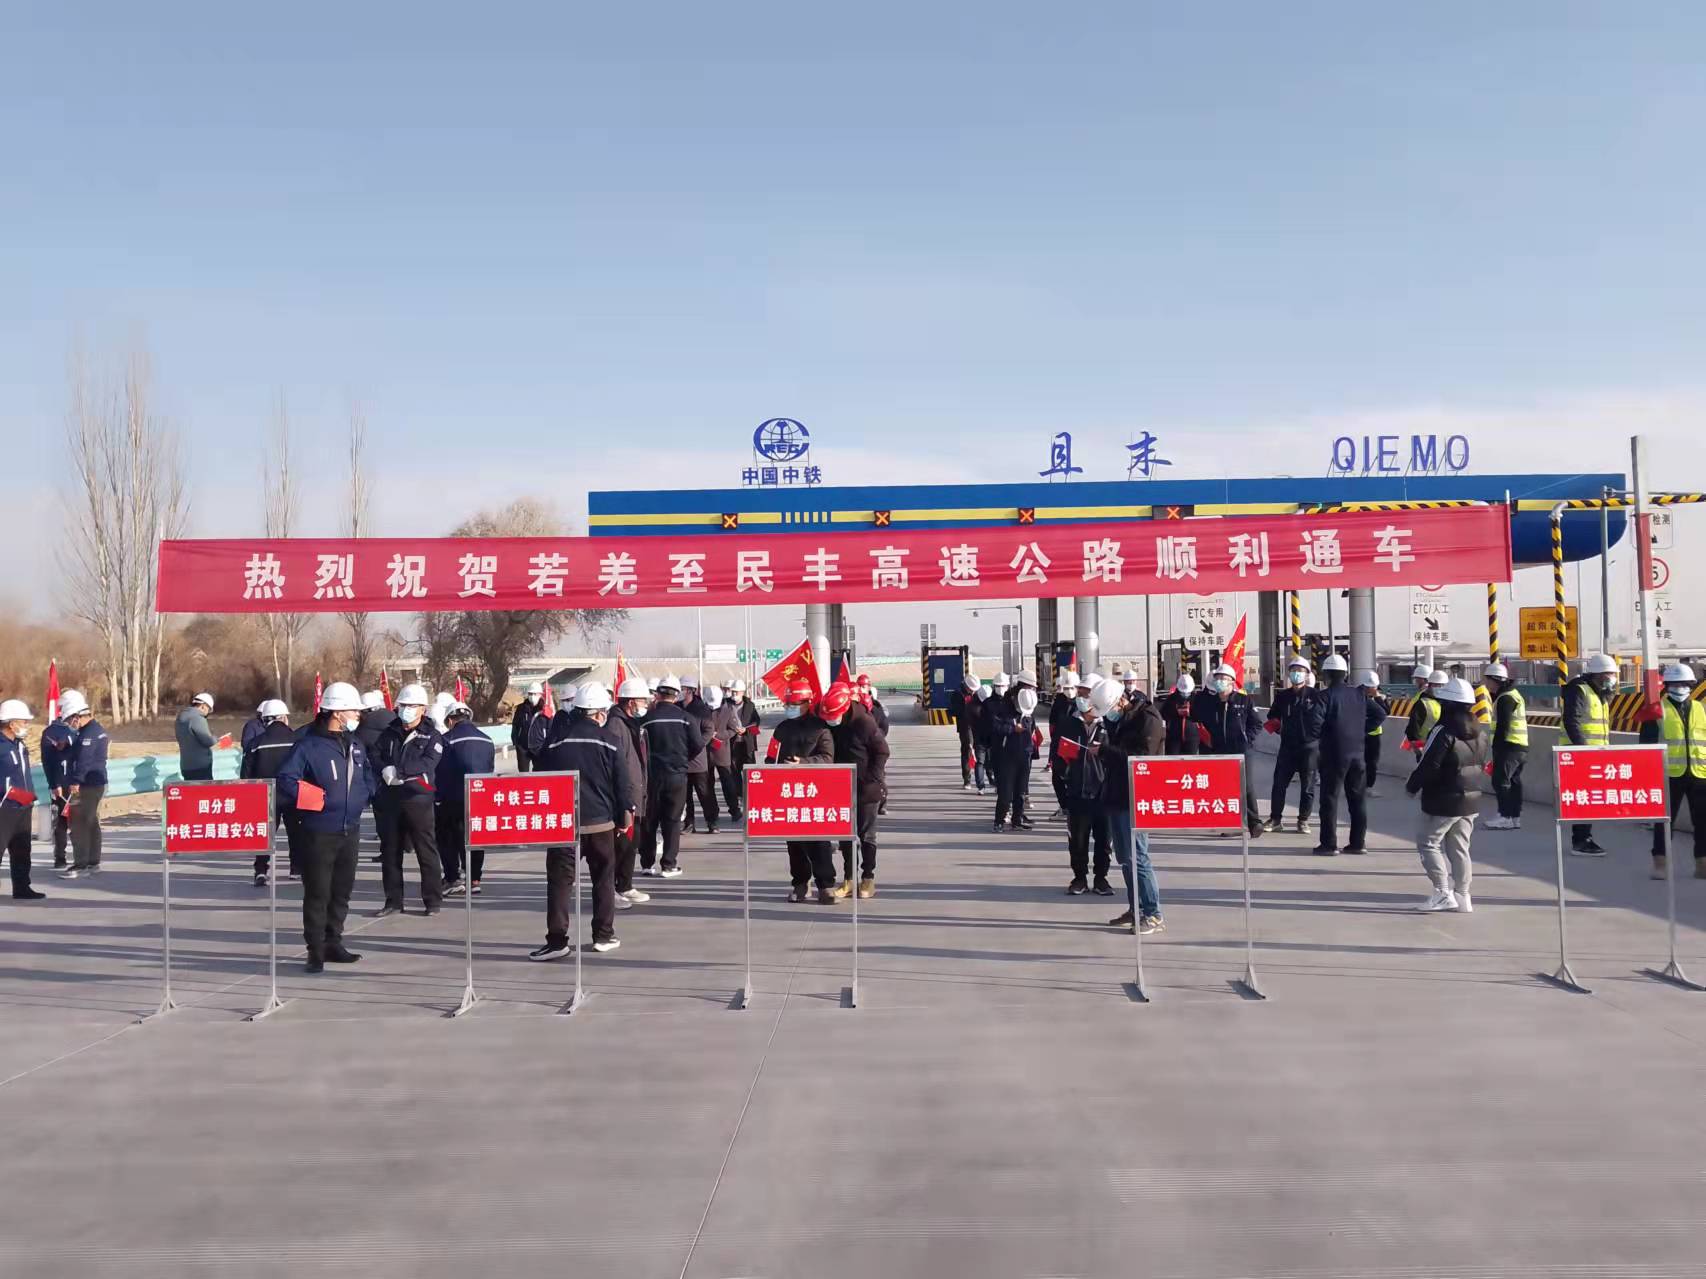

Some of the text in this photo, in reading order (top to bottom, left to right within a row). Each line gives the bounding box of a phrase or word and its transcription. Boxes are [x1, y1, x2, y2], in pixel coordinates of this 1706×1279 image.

[1038, 431, 1172, 476] 且末
[1333, 434, 1469, 472] QIEMO
[742, 466, 821, 485] 中国中铁
[243, 526, 1415, 601] 热烈祝贺若羌至民丰高速公路顺利通车
[1188, 607, 1224, 619] ETC专用
[1189, 635, 1224, 646] 保持车距
[1589, 763, 1633, 780] 二分部
[780, 781, 818, 798] 总监办
[1165, 773, 1209, 790] 一分部
[198, 797, 236, 814] 四分部
[493, 789, 550, 807] 中铁三局
[1561, 788, 1663, 806] 中铁三局四公司
[748, 806, 851, 823] 中铁二院监理公司
[1137, 798, 1240, 816] 中铁三局六公司
[166, 821, 268, 840] 中铁三局建安公司
[471, 813, 573, 832] 南疆工程指挥部
